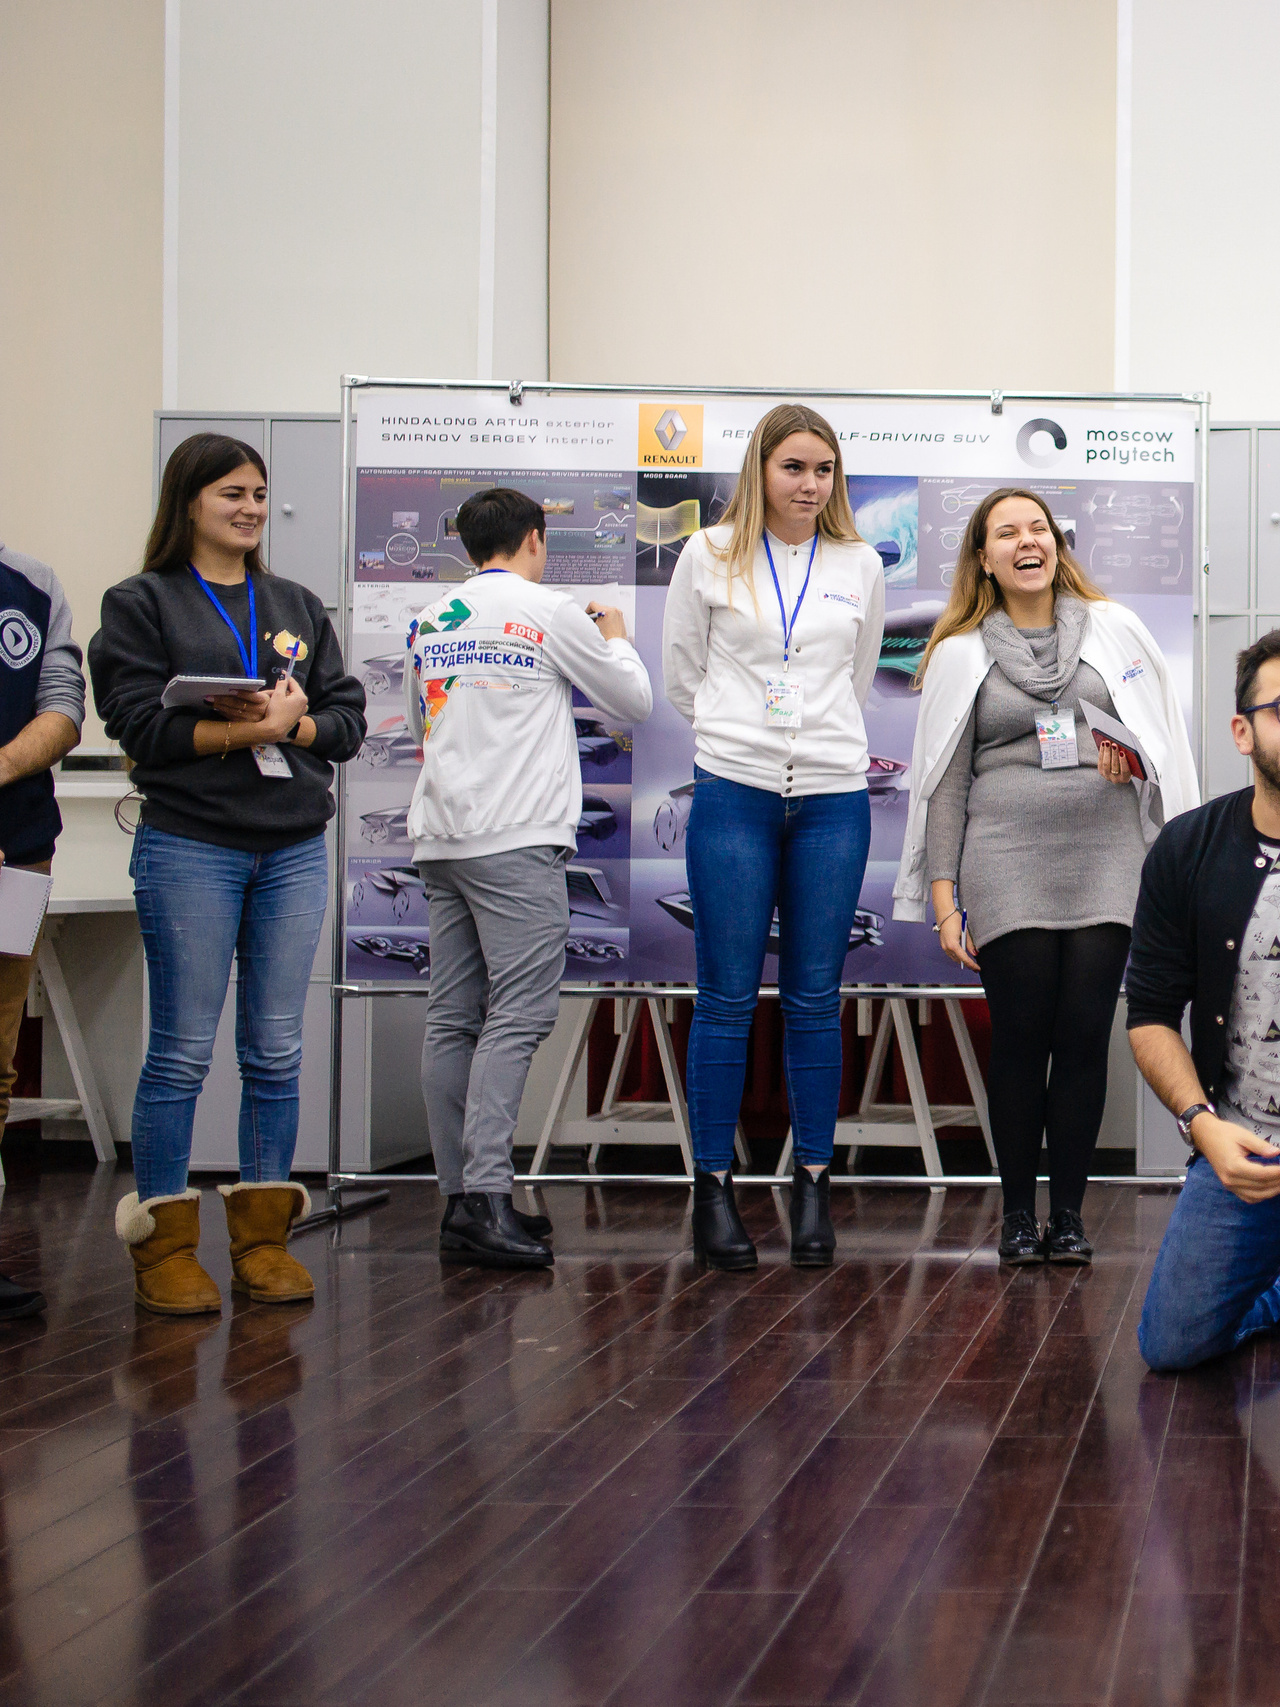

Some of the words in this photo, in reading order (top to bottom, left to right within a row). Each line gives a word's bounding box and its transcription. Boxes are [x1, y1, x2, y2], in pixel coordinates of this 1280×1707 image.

[381, 416, 478, 426] HINDALONG
[485, 418, 540, 427] ARTUR
[546, 419, 615, 429] exterior
[381, 433, 462, 443] SMIRNOV
[470, 434, 538, 444] SERGEY
[545, 435, 615, 445] interior
[834, 431, 946, 443] LF-DRIVING
[953, 433, 991, 444] SUV
[1086, 429, 1174, 443] moscow
[643, 454, 698, 465] RENAULT
[1086, 446, 1175, 465] polytech
[509, 623, 540, 641] 2018
[424, 640, 477, 657] РОССИЯ
[478, 640, 536, 652] ОБЩЕРОССИЙСКИЙ
[425, 652, 535, 669] СТУДЕНЧЕСКАЯ
